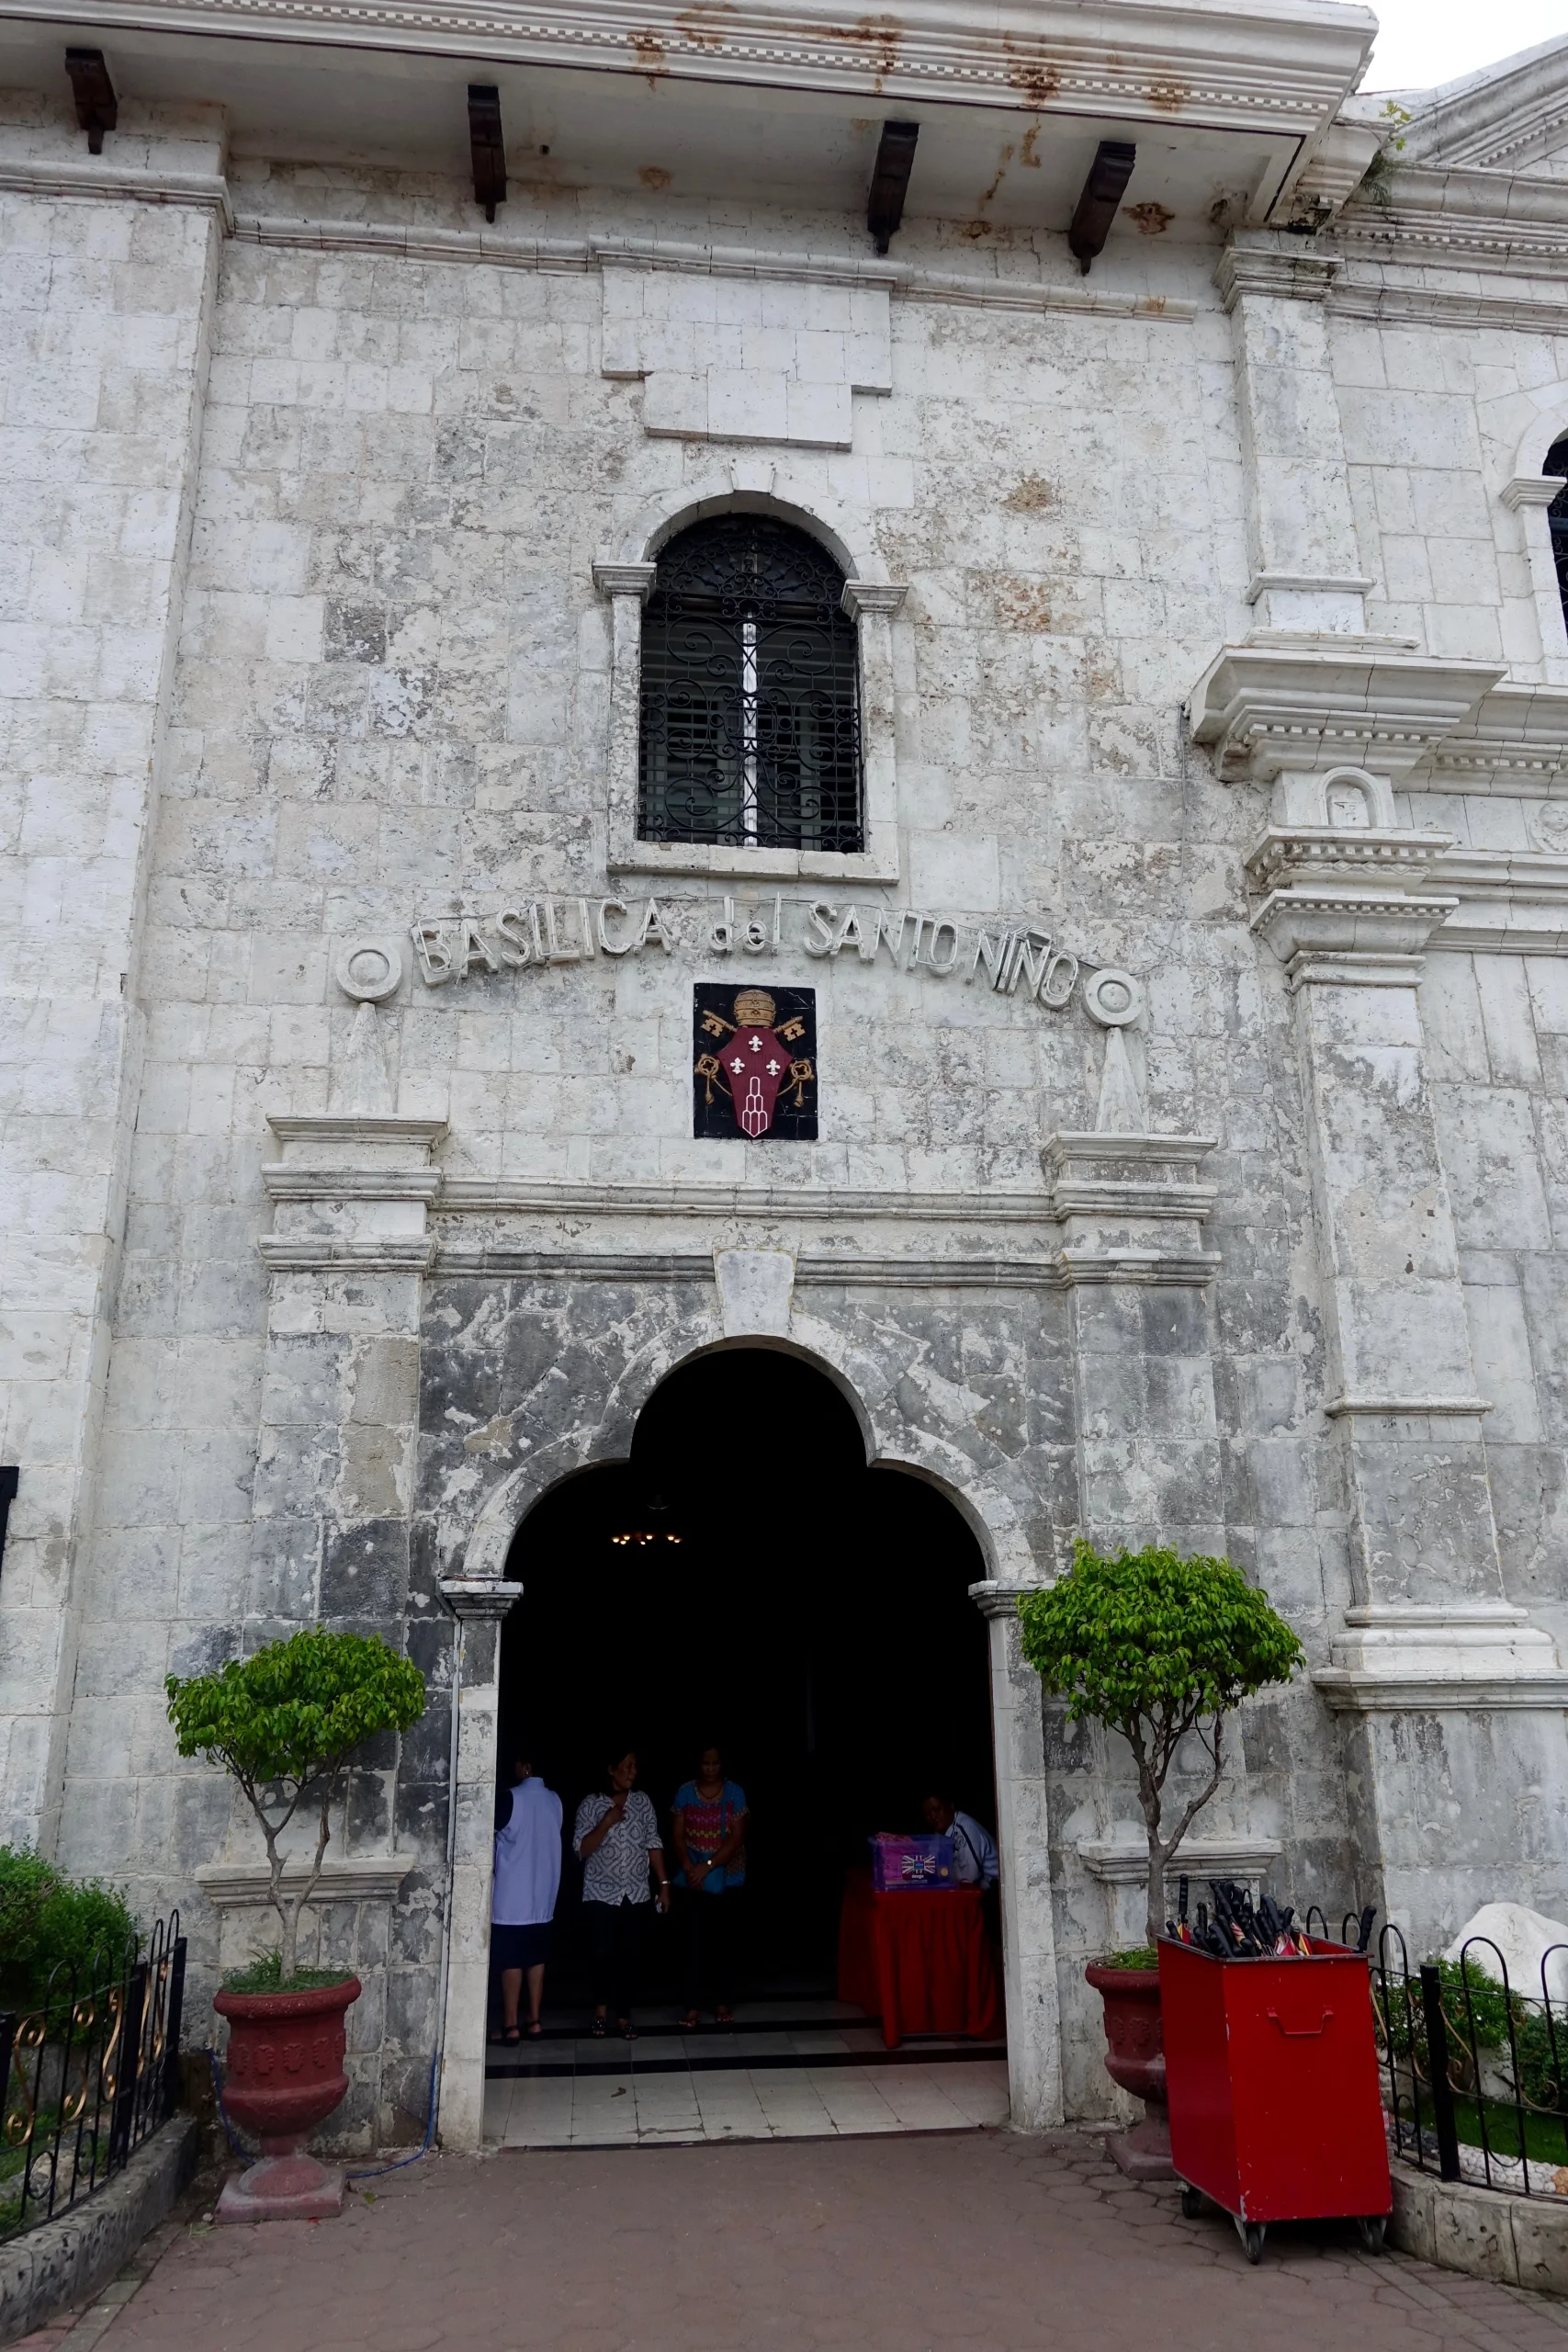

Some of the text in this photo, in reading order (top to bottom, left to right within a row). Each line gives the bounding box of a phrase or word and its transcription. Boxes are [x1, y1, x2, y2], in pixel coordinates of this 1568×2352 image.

[411, 892, 1078, 1010] BASILICA del SANTO NIÑO
